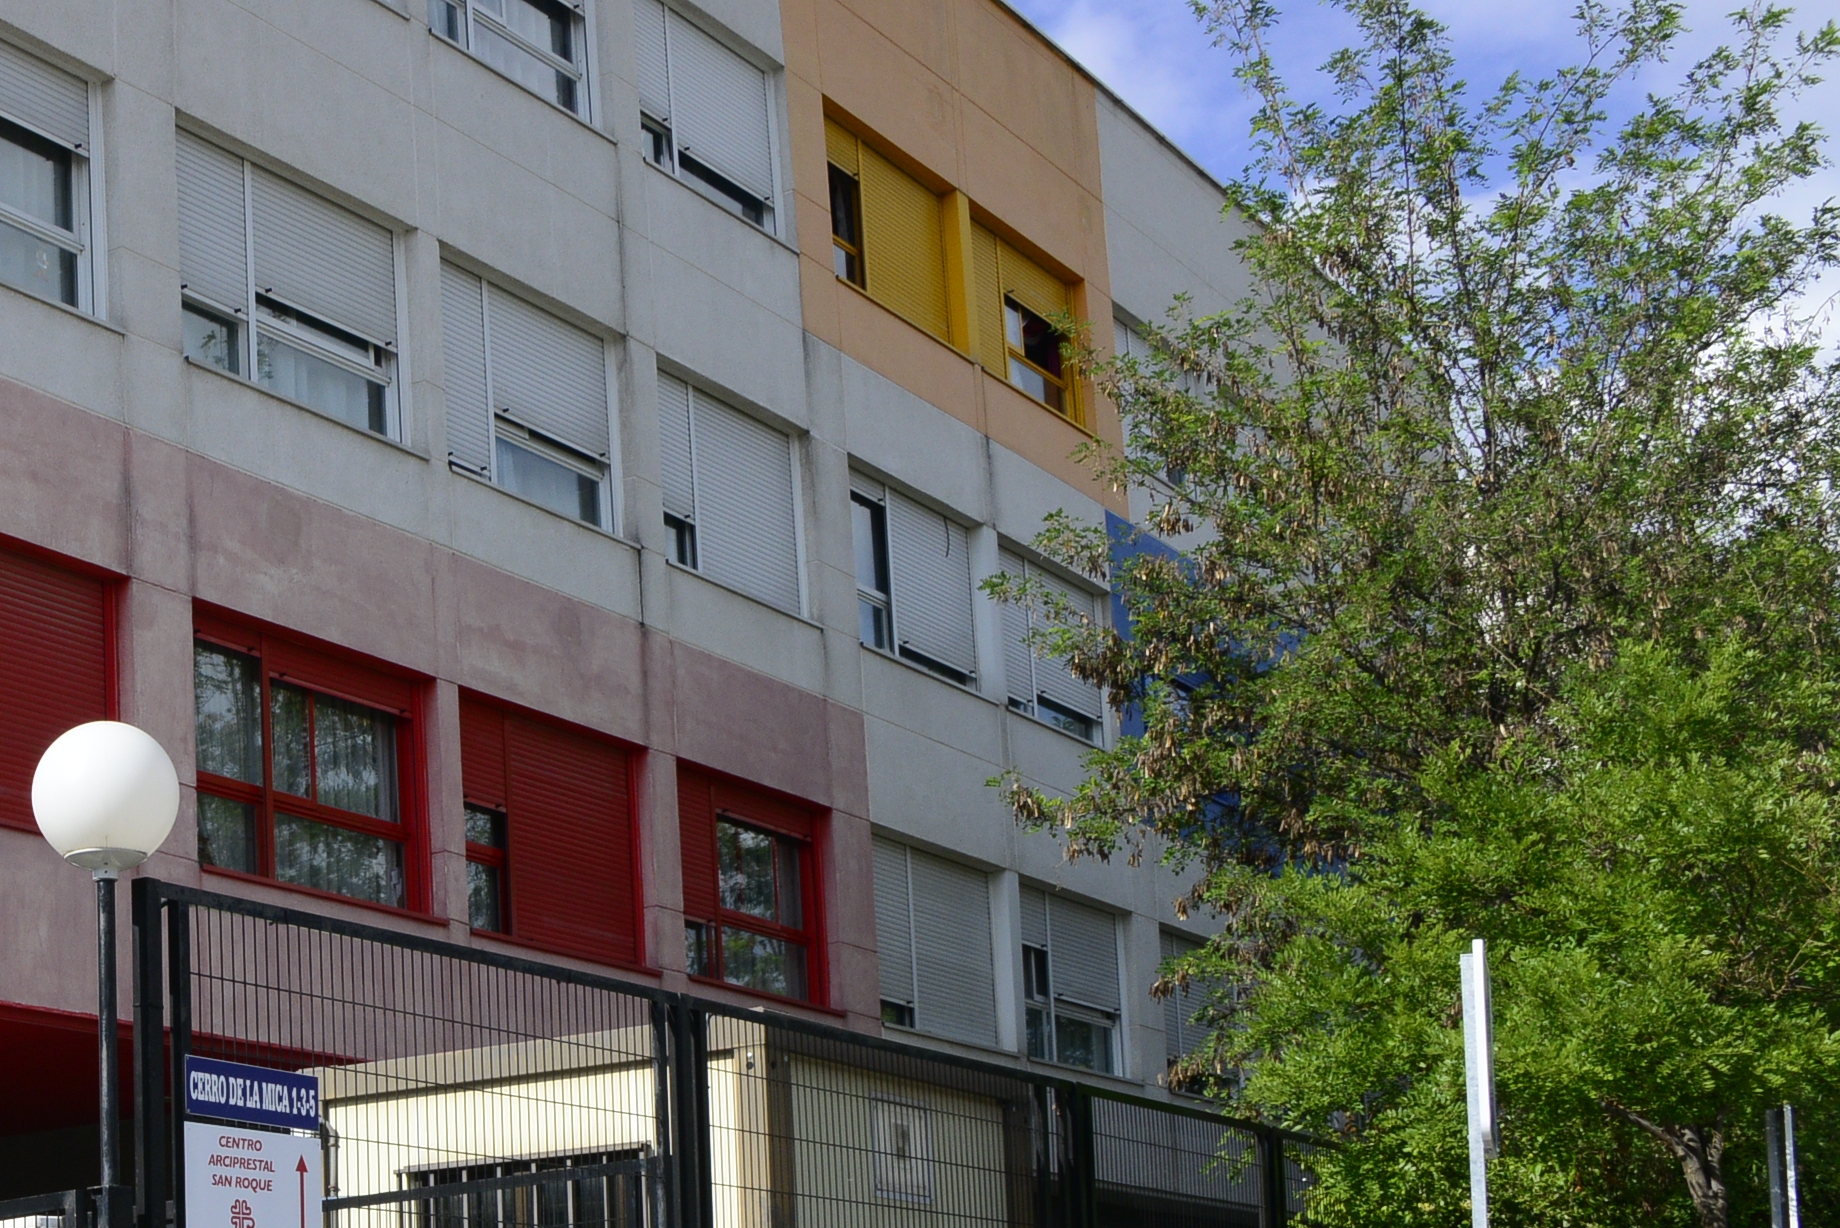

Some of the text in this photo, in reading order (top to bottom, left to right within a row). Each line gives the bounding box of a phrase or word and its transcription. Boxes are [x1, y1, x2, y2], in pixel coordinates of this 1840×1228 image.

[190, 1071, 316, 1117] CERRO DE LA MICA 1-3-5
[218, 1135, 263, 1152] CENTRO
[208, 1154, 275, 1173] ARCIPRESTAL
[211, 1174, 273, 1193] SAN ROQUE
